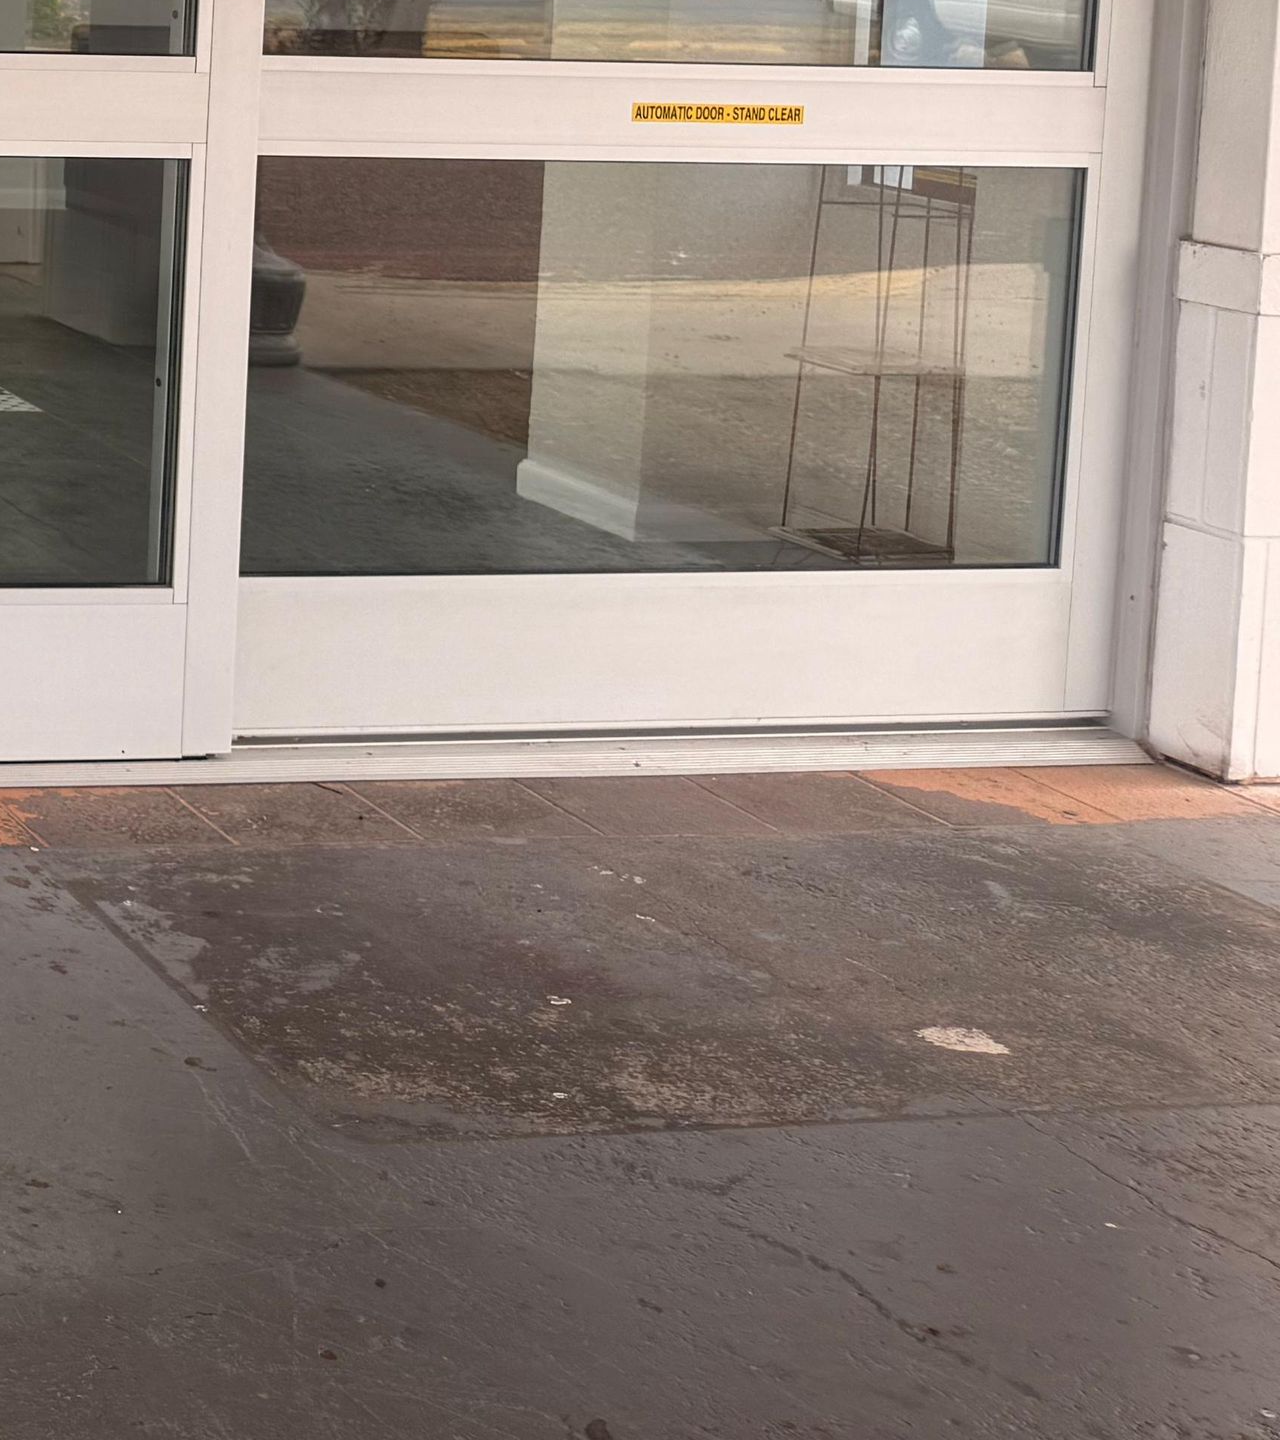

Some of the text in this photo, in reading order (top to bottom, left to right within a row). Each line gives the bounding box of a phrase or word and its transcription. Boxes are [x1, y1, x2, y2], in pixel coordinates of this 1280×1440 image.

[634, 105, 693, 120] AUTOMATIC
[695, 106, 724, 120] DOOR
[732, 107, 765, 121] STAND
[768, 108, 801, 122] CLEAR
